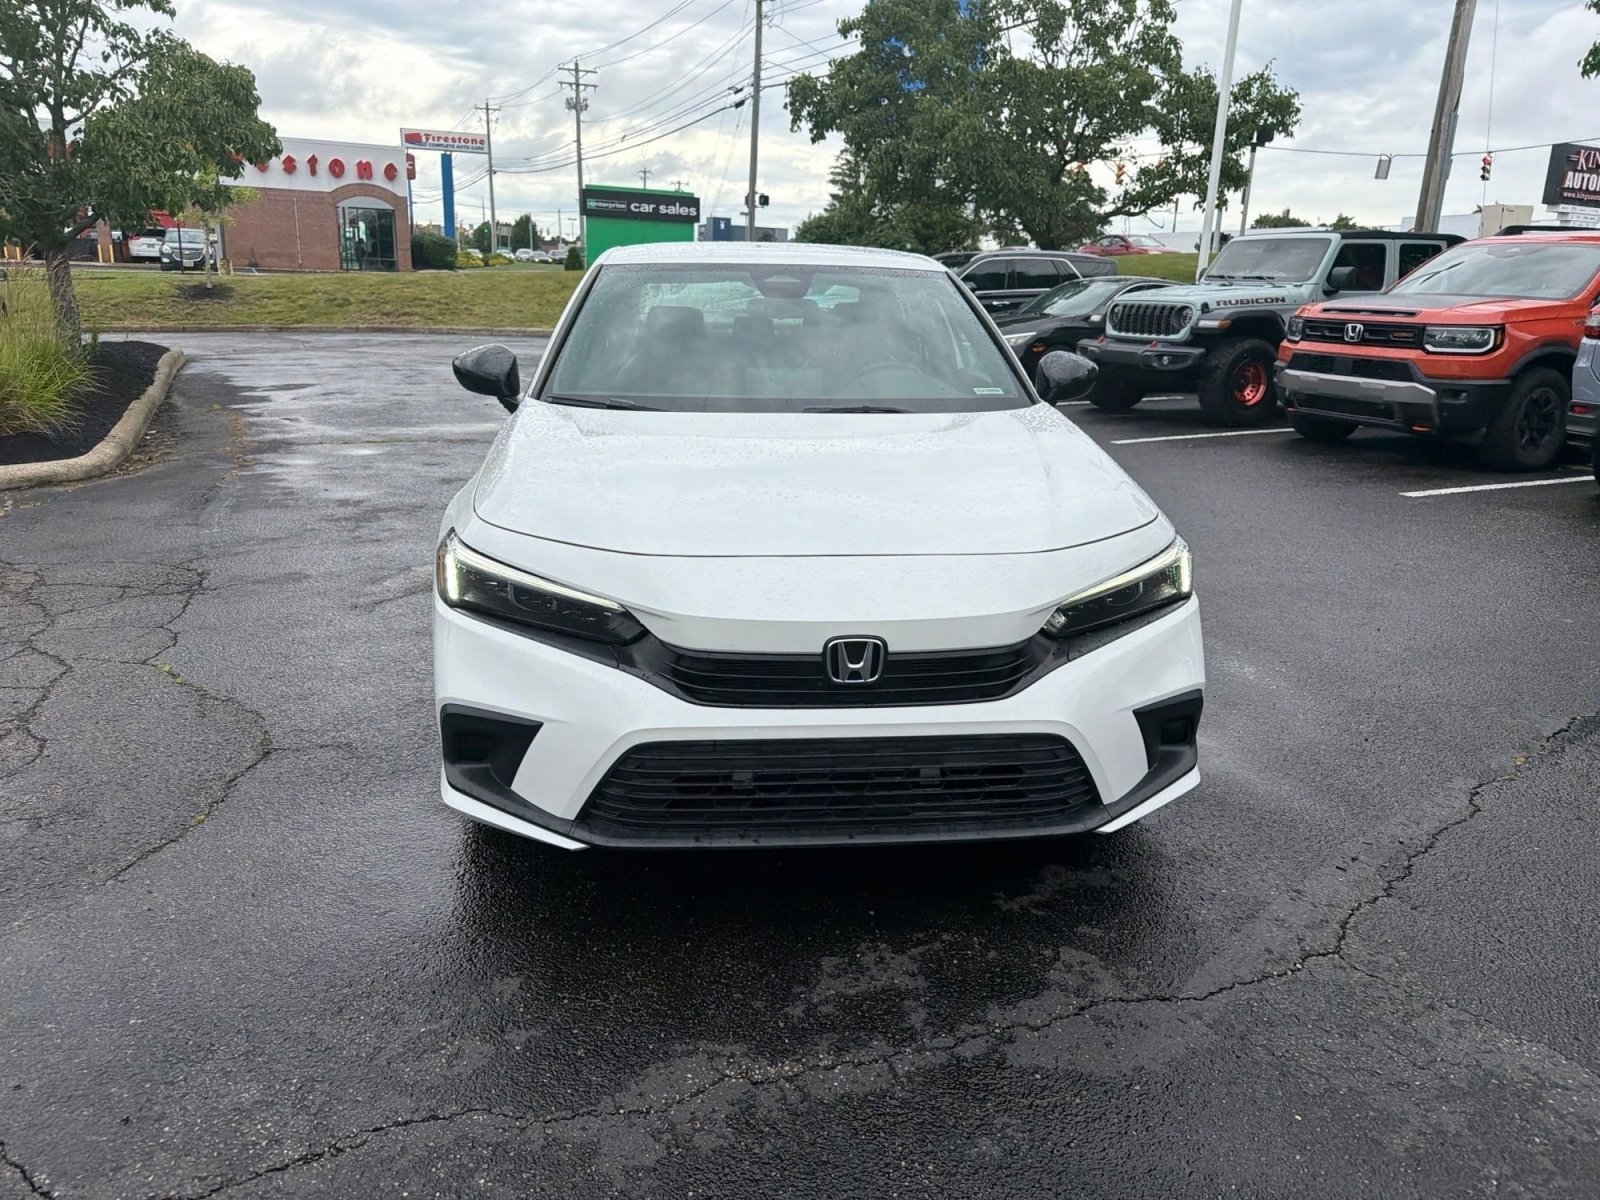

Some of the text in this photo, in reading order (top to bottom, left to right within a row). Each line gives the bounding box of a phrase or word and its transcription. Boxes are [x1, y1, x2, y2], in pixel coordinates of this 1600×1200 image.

[423, 133, 486, 146] Firestone
[630, 202, 656, 213] car
[659, 202, 697, 216] sales
[1216, 296, 1286, 307] RUBICON
